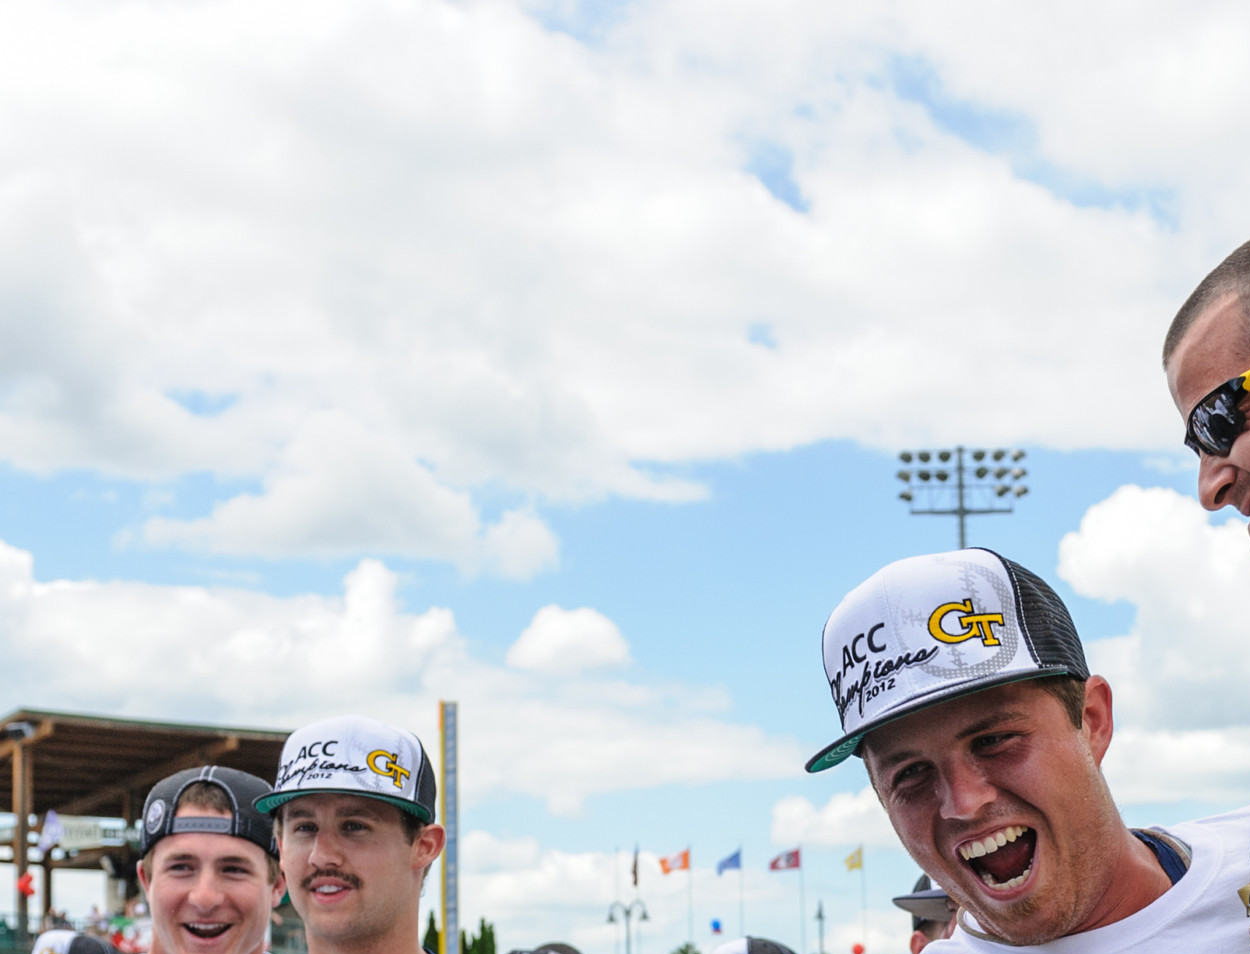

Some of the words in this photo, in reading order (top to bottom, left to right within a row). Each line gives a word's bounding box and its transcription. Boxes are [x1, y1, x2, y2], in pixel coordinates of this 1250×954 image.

[928, 598, 1005, 647] GT
[842, 622, 887, 678] ACC
[866, 678, 896, 702] 2012
[295, 740, 339, 764] ACC
[307, 773, 333, 781] 2012
[366, 749, 410, 789] GT
